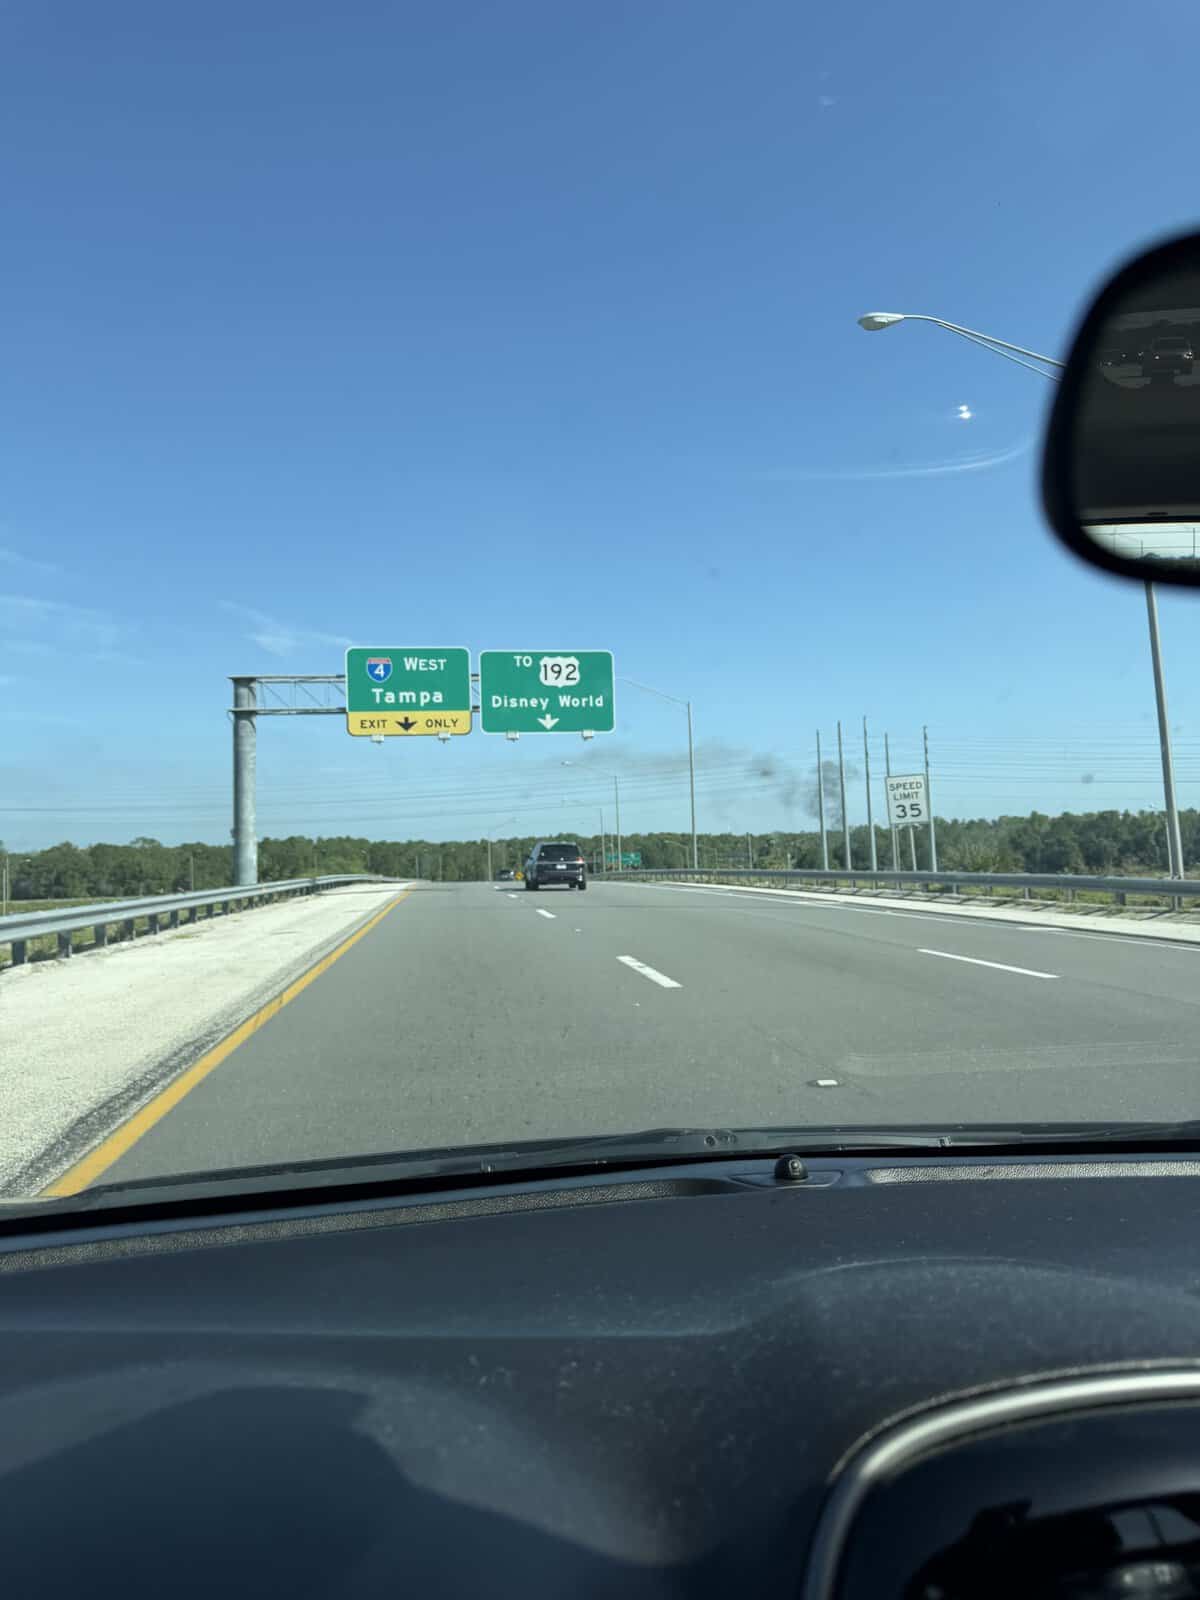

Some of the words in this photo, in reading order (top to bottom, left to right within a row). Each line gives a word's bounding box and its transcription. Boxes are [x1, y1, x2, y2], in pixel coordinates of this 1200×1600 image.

[374, 663, 385, 677] 4
[403, 657, 447, 671] WEST
[513, 655, 533, 668] TO
[542, 663, 578, 681] 192
[371, 688, 444, 706] Tampa
[491, 695, 549, 710] Disney
[558, 695, 604, 708] World
[360, 719, 388, 729] EXIT
[425, 718, 459, 728] ONLY
[889, 781, 922, 791] SPEED
[893, 791, 920, 800] LIMIT
[895, 803, 922, 818] 35
